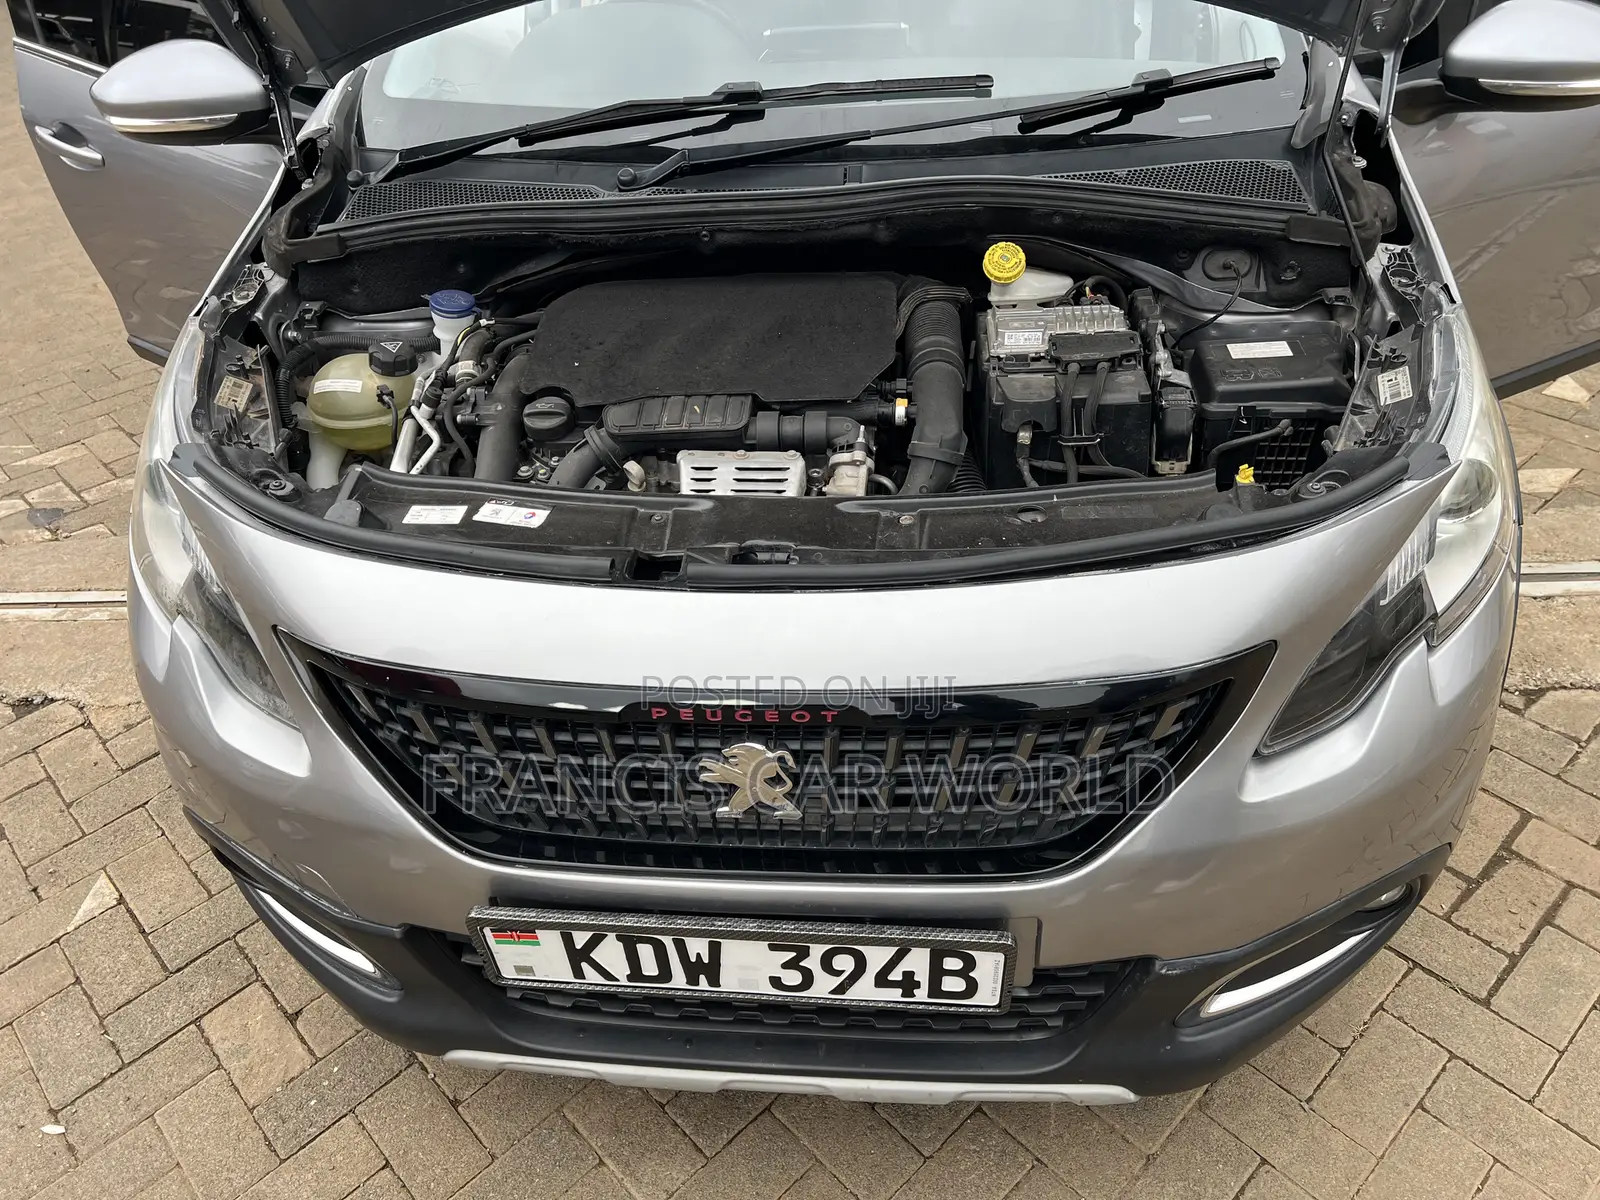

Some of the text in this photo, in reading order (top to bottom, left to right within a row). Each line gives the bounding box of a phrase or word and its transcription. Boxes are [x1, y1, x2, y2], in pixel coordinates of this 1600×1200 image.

[651, 707, 841, 722] PEUGEOT
[562, 931, 723, 988] KDW
[768, 943, 979, 1000] 394B
